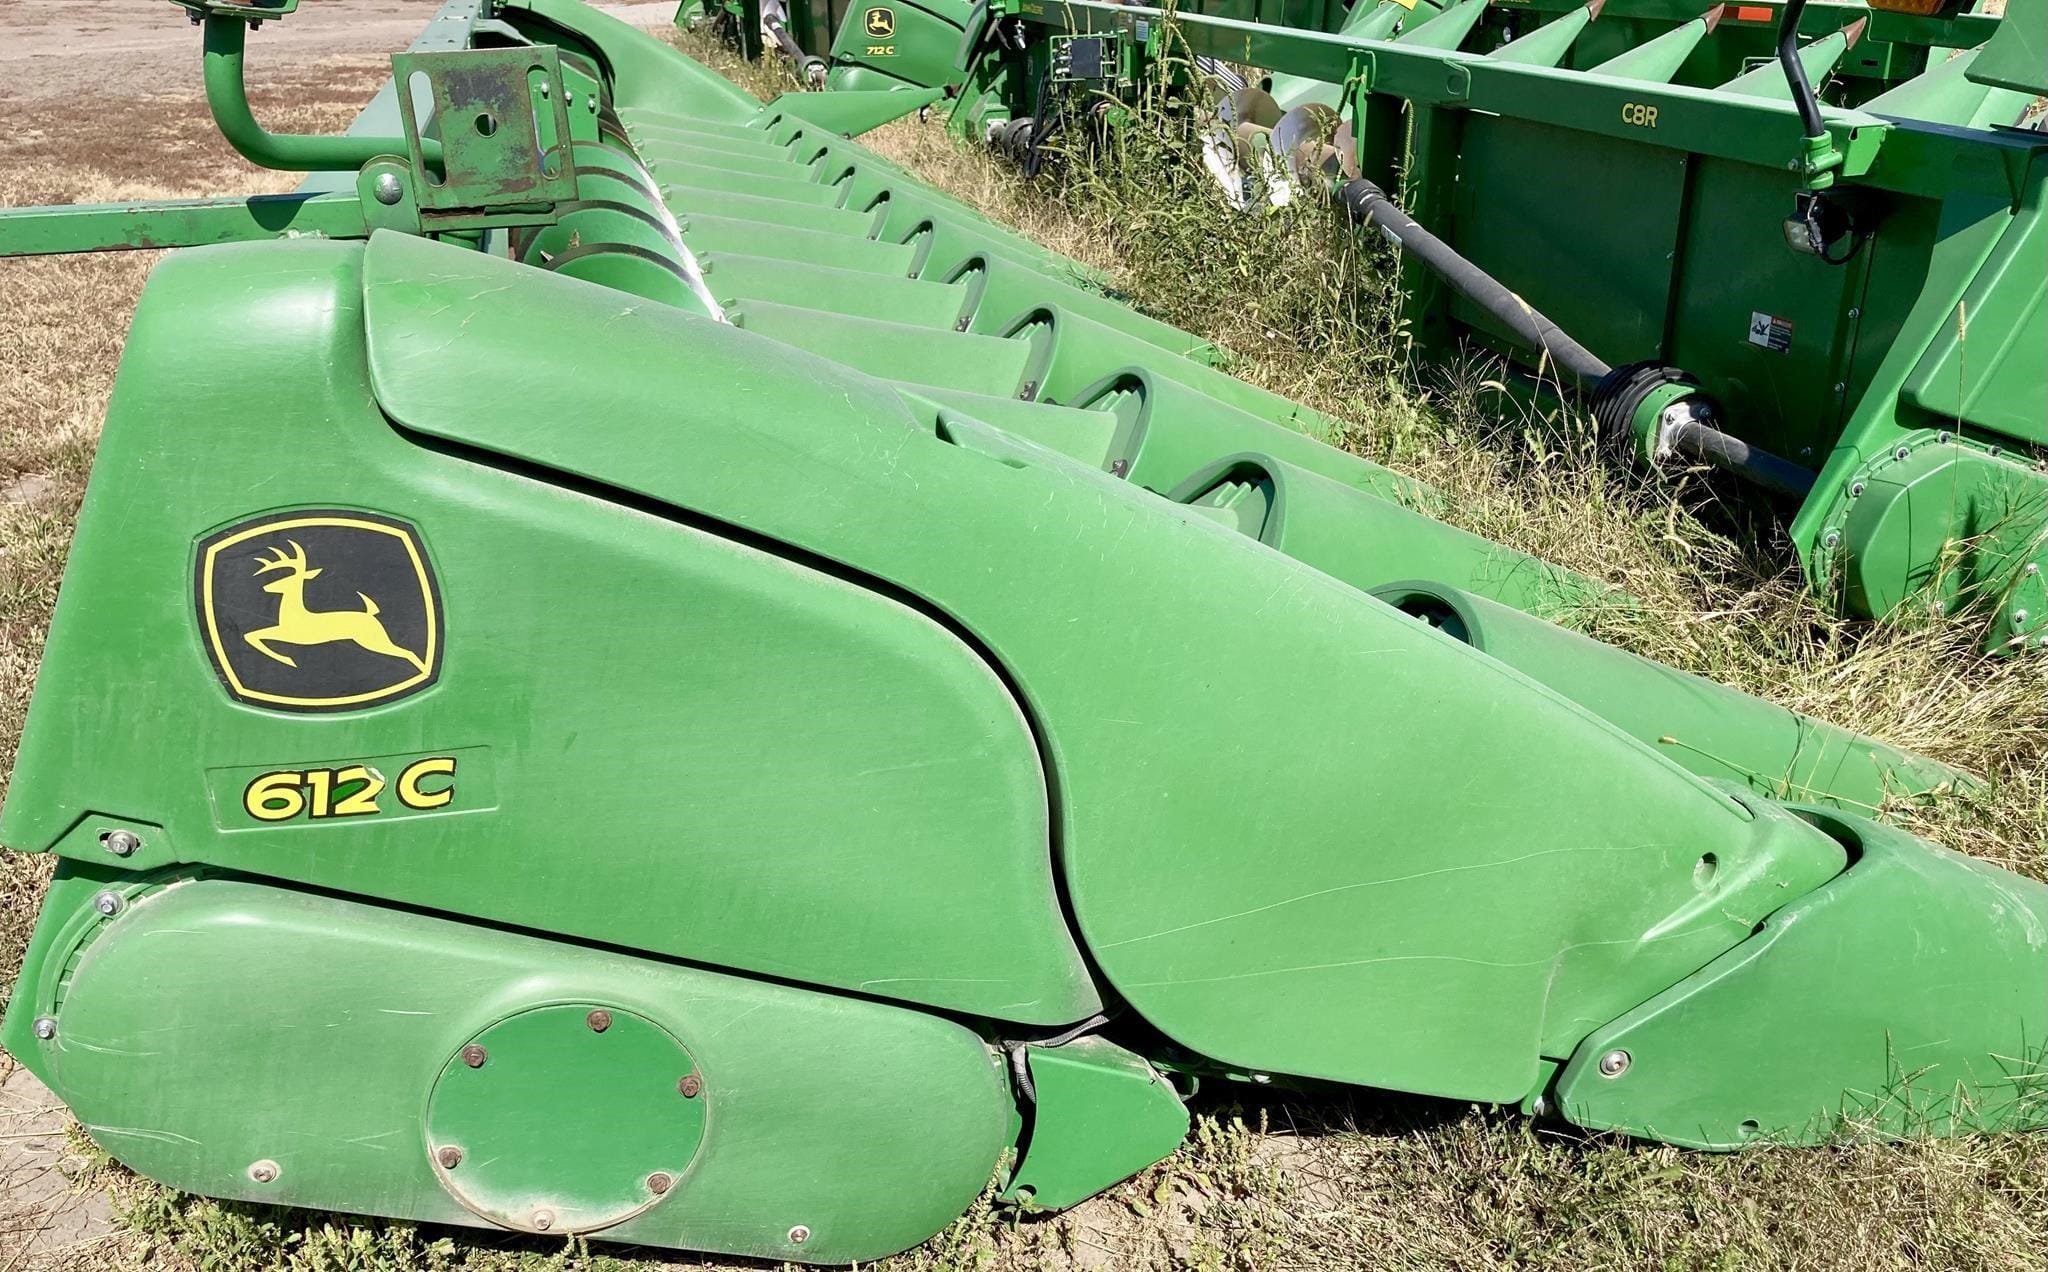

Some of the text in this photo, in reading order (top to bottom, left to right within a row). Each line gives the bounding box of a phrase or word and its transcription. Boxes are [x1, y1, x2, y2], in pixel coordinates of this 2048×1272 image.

[866, 45, 895, 56] 712 C
[1622, 102, 1658, 128] C8R
[243, 756, 457, 822] 612 C
